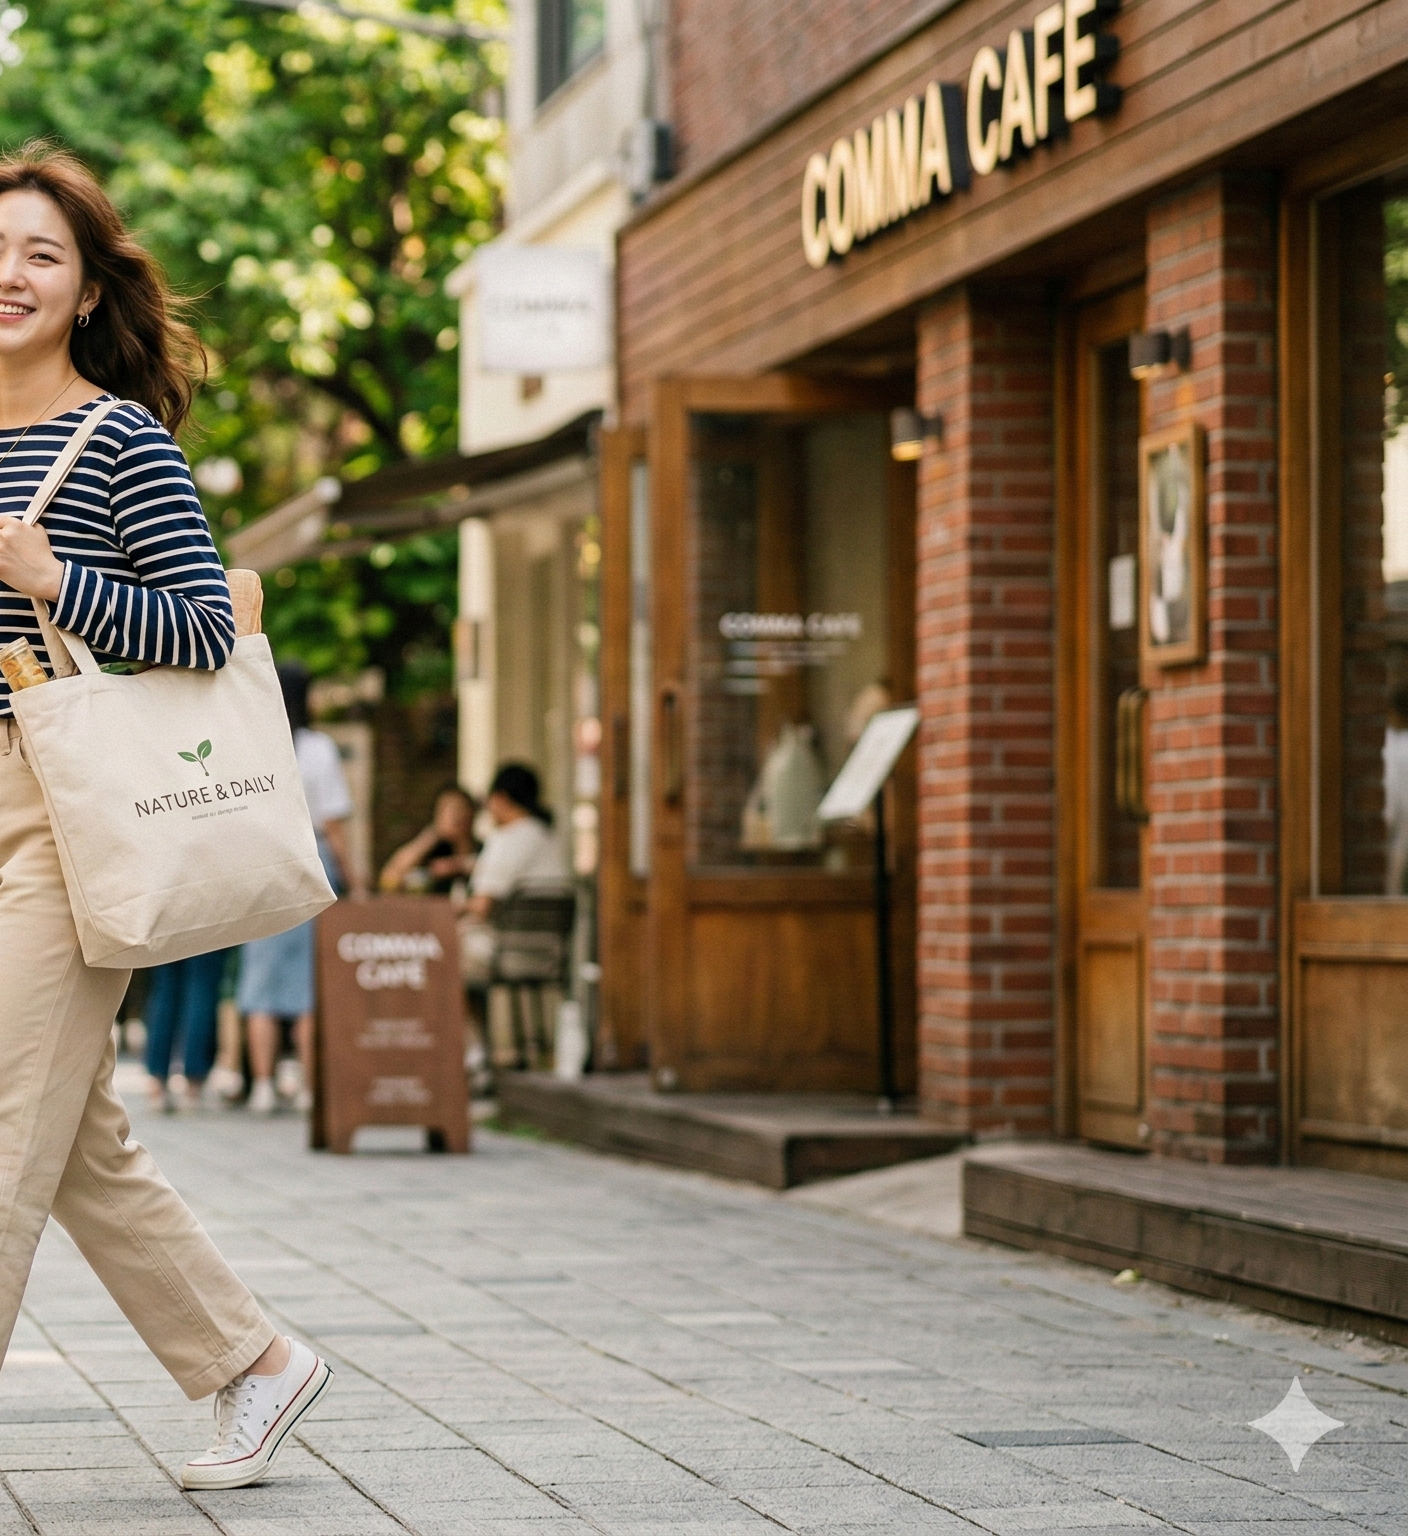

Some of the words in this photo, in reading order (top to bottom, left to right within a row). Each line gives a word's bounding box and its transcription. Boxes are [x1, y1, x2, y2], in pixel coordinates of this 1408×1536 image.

[802, 81, 952, 268] COMMA
[967, 0, 1096, 175] CAFE
[135, 786, 212, 818] NATURE
[215, 784, 230, 801] &
[230, 774, 276, 798] DAILY
